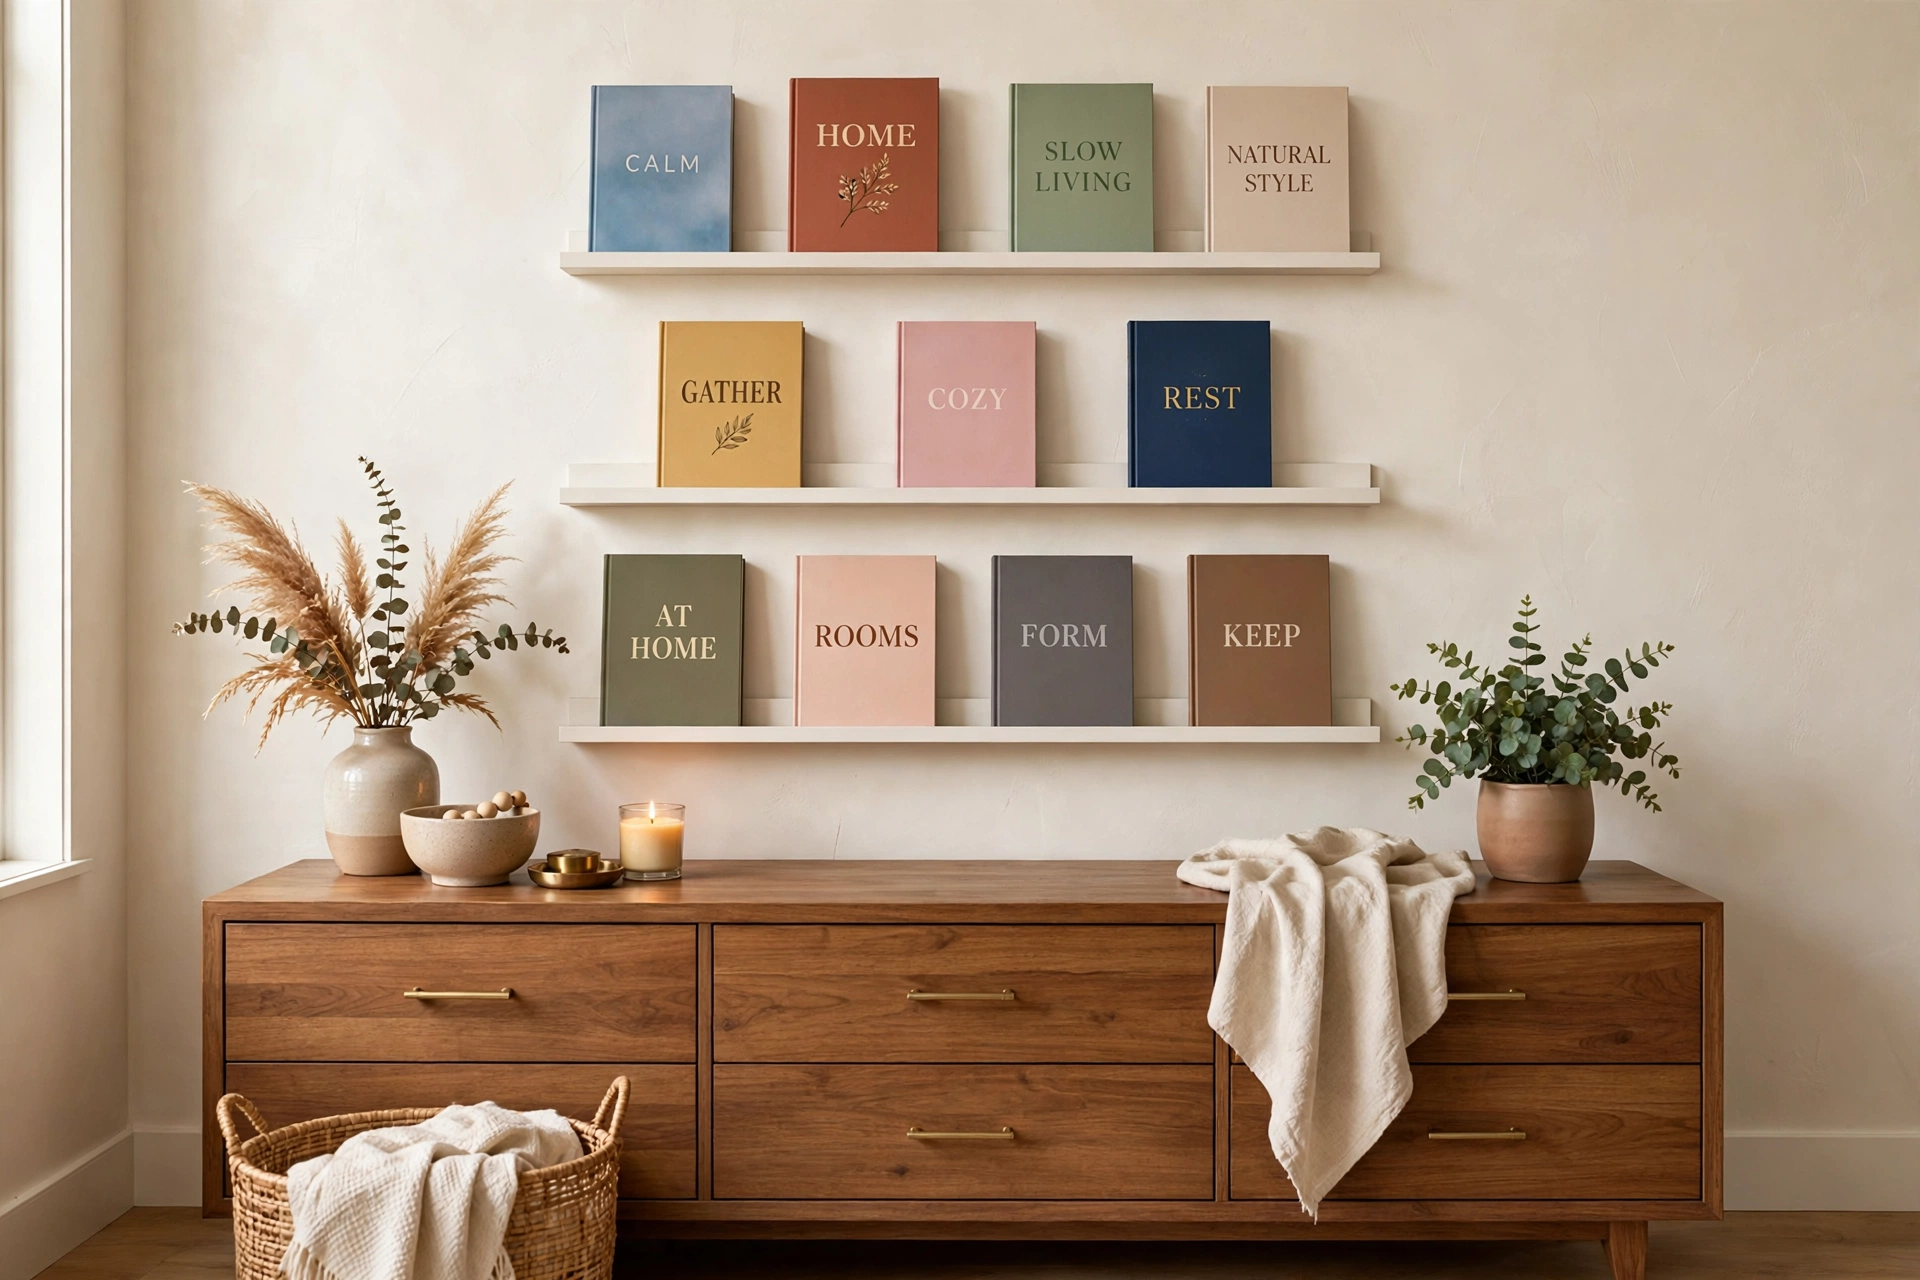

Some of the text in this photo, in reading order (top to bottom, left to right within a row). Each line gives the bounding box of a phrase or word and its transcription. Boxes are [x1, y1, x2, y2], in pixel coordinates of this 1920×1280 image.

[817, 124, 915, 147] HOME
[1046, 141, 1122, 160] SLOW
[1228, 145, 1330, 163] NATURAL
[626, 154, 698, 173] CALM
[1036, 172, 1131, 192] LIVING
[1246, 174, 1313, 192] STYLE
[682, 380, 781, 403] GATHER
[928, 388, 1006, 410] COZY
[1164, 387, 1240, 409] REST
[656, 605, 692, 626] AT
[816, 624, 918, 647] ROOMS
[1022, 624, 1107, 647] FORM
[1224, 624, 1300, 647] KEEP
[631, 637, 716, 659] HOME
